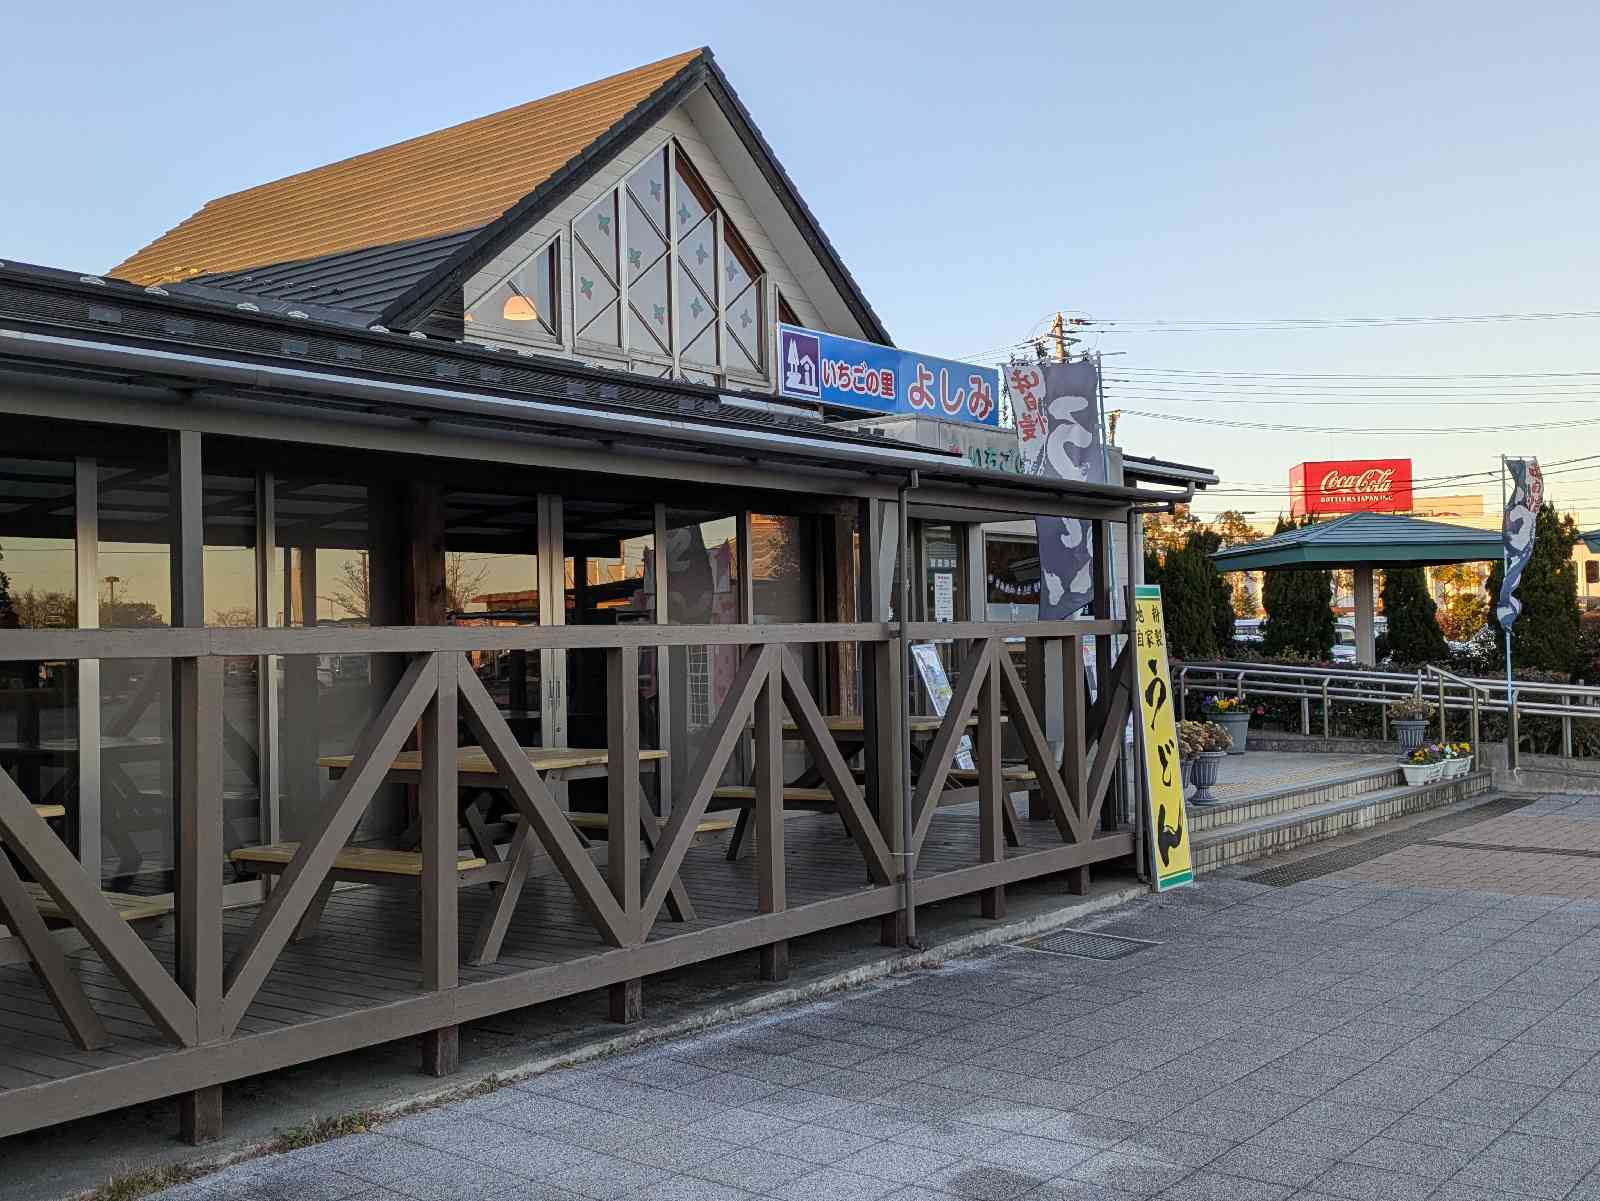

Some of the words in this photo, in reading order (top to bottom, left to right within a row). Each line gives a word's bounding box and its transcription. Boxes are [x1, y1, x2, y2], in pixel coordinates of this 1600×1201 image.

[822, 358, 896, 398] いちごの里
[908, 362, 995, 420] よしみ
[1136, 628, 1163, 649] 自家製
[1145, 659, 1183, 867] うどん
